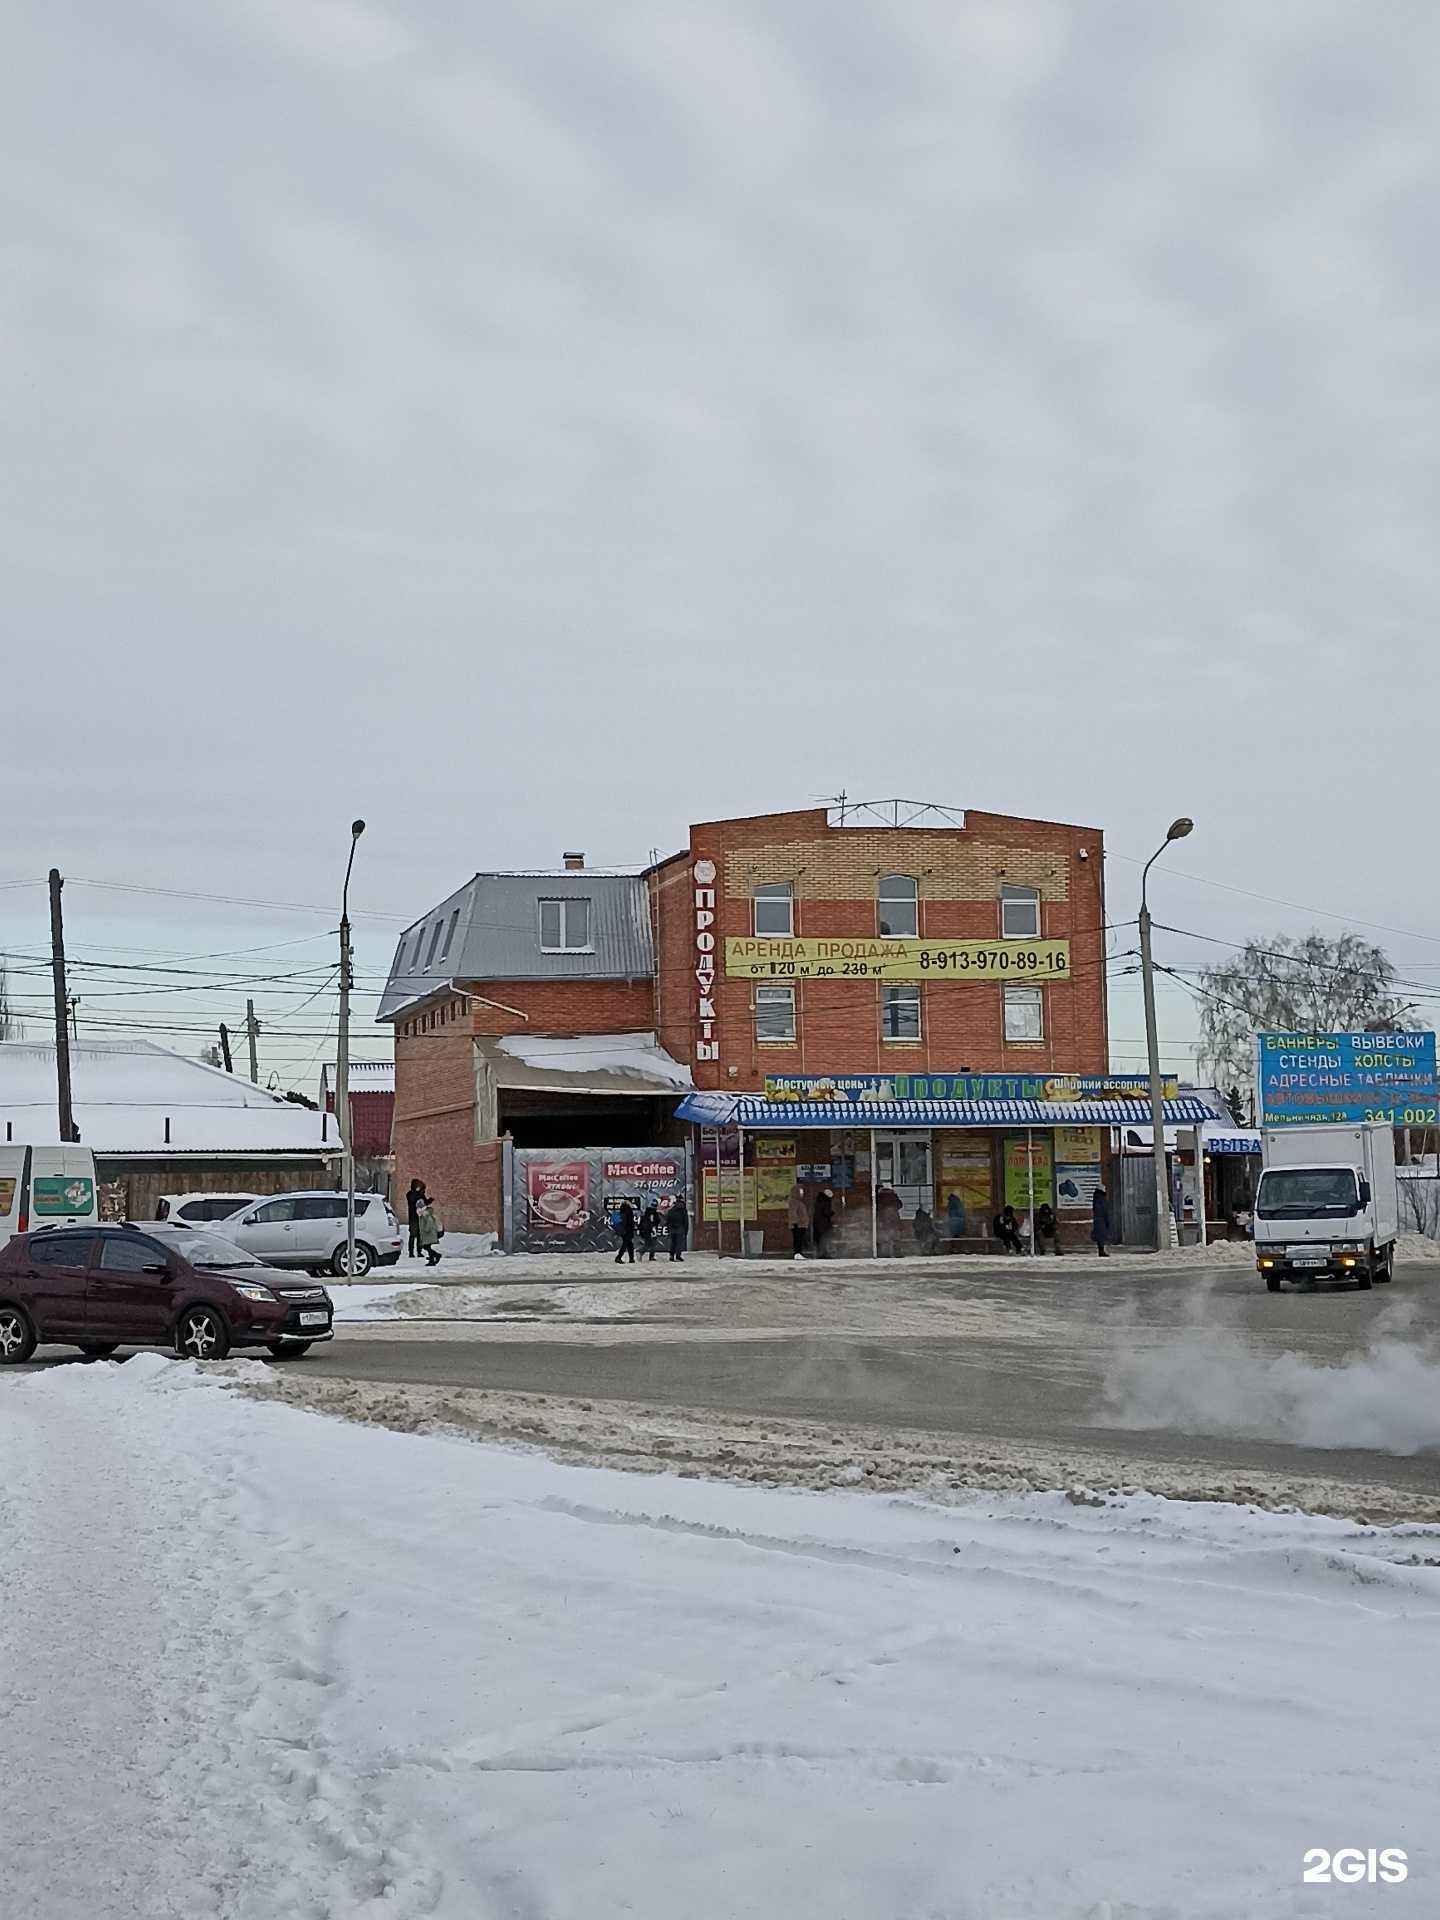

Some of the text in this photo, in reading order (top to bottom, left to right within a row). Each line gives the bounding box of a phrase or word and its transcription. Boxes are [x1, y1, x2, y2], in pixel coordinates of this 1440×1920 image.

[732, 942, 908, 961] АРЕНДА ПРОДАЖА
[920, 951, 1066, 970] 8-913-970-89-16
[695, 888, 719, 1061] ПРОДУКТЫ
[750, 965, 765, 975] от
[816, 966, 834, 976] до
[842, 963, 868, 975] 230
[1266, 1036, 1424, 1050] БАННЕРЫ ВЫВЕСКИ
[1279, 1055, 1415, 1069] СТЕНДЫ ХОЛСТЫ
[837, 1080, 867, 1090] цены
[1269, 1074, 1351, 1088] АДРЕСНЫЕ
[1364, 1109, 1436, 1124] 341-002
[1208, 1138, 1261, 1152] РЫБА
[607, 1164, 675, 1176] MacCoffee
[538, 1174, 578, 1182] MacCoffee
